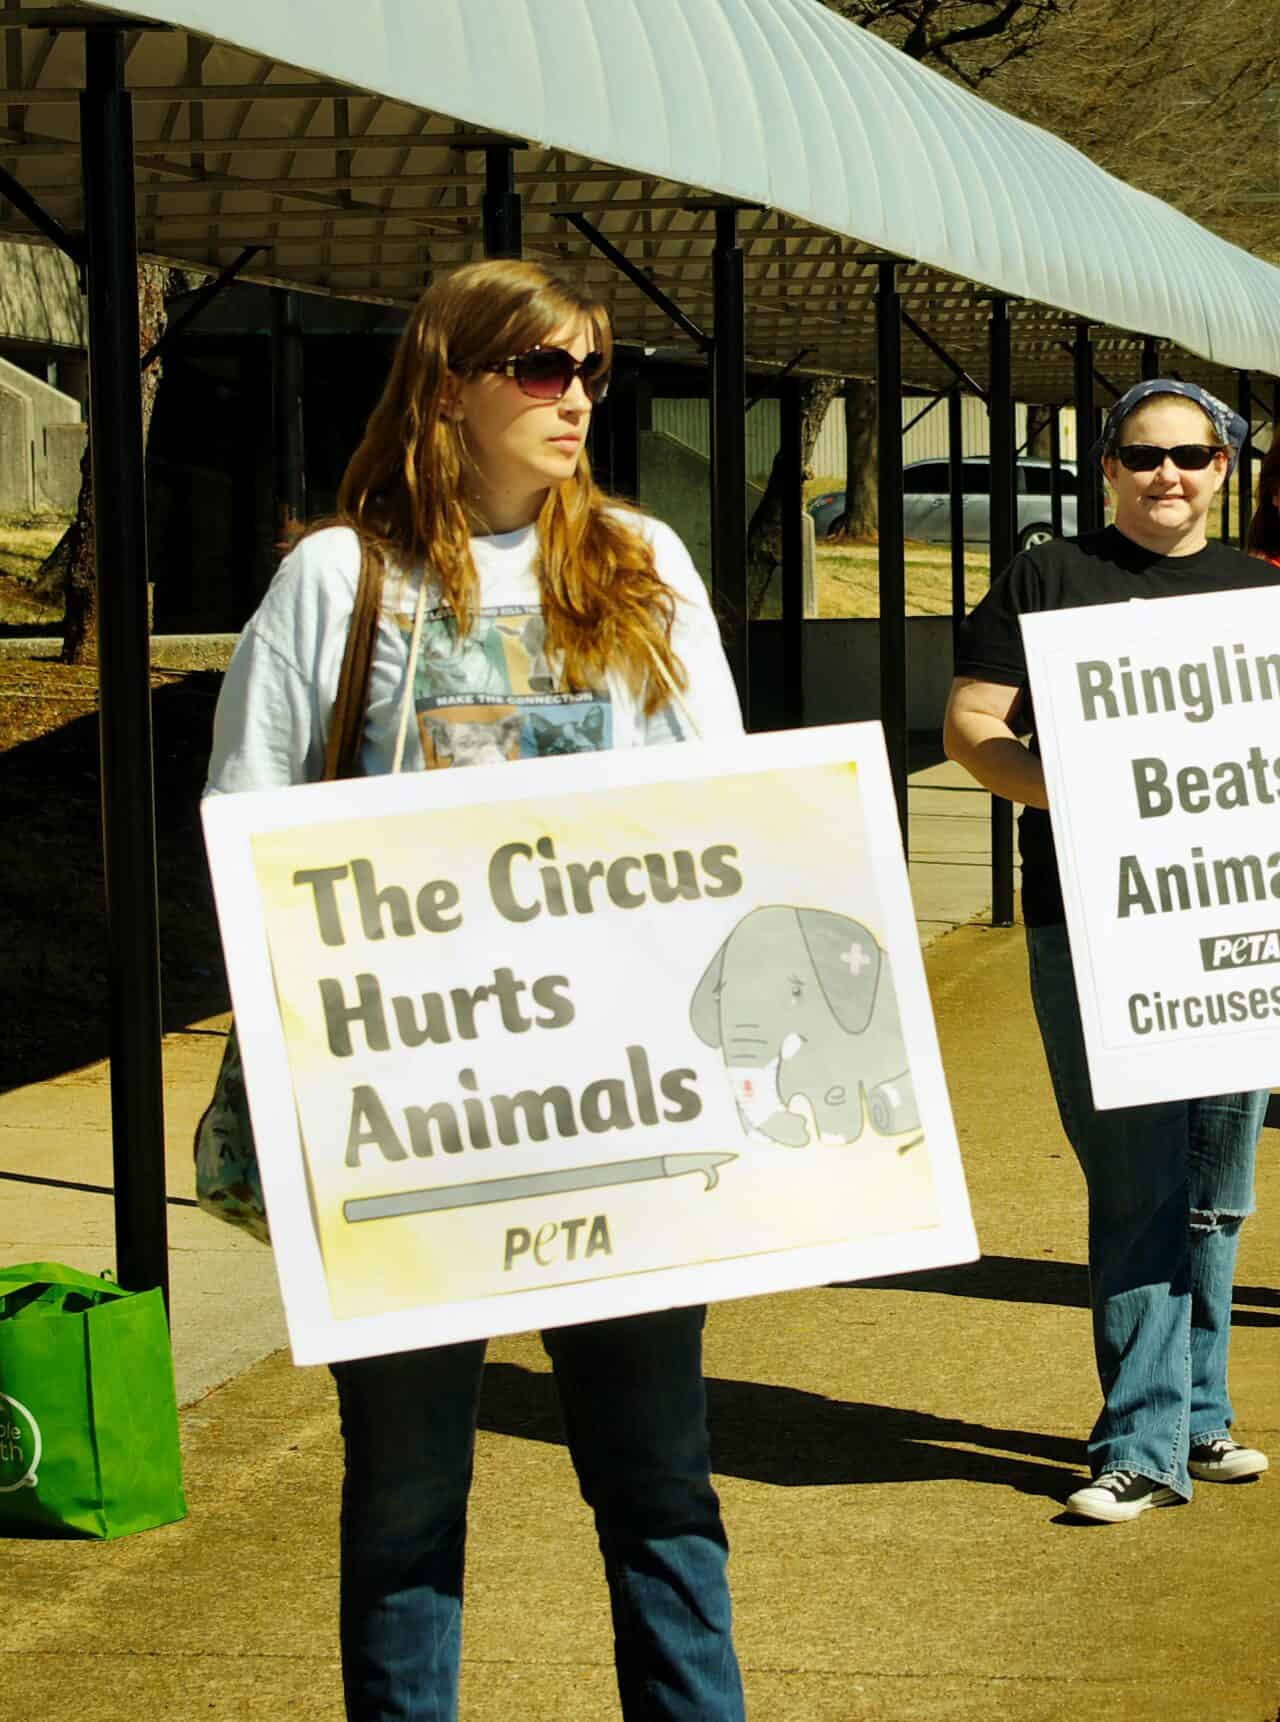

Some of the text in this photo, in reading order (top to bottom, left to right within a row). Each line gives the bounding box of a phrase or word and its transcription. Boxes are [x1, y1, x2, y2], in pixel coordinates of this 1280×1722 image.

[292, 835, 743, 947] The Circus
[318, 966, 576, 1058] Hurts
[342, 1042, 703, 1169] Animals
